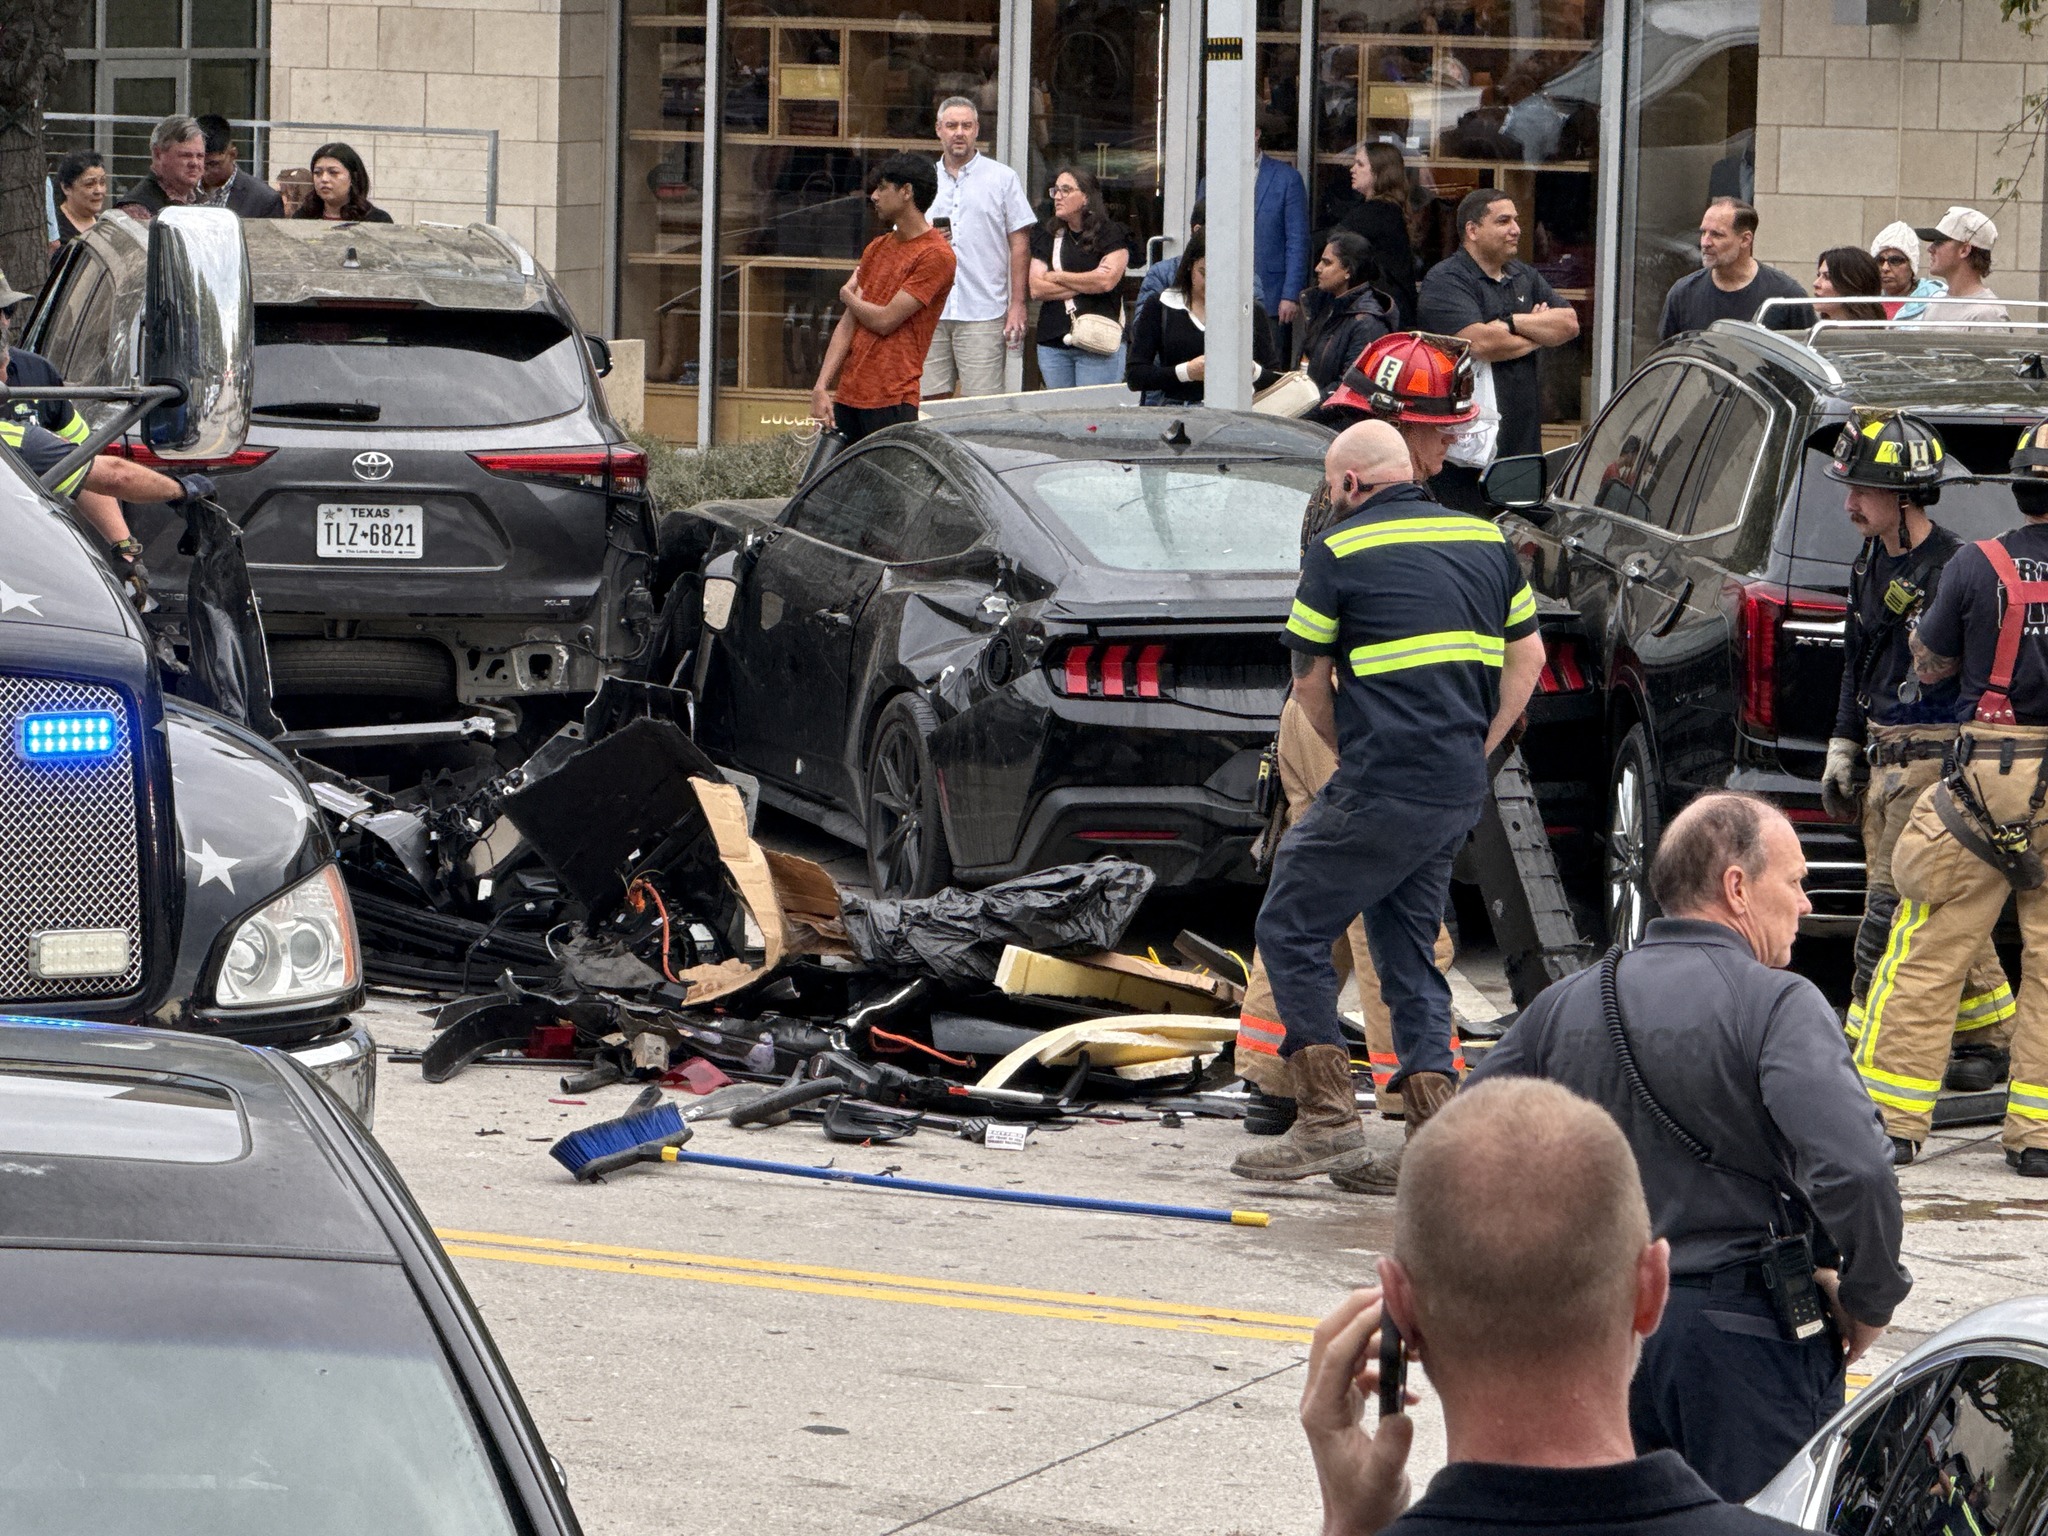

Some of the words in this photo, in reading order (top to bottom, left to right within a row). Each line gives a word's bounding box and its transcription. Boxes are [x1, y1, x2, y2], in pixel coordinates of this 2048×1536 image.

[350, 507, 391, 519] TEXAS
[324, 522, 359, 546] TLZ
[369, 522, 416, 547] 6821
